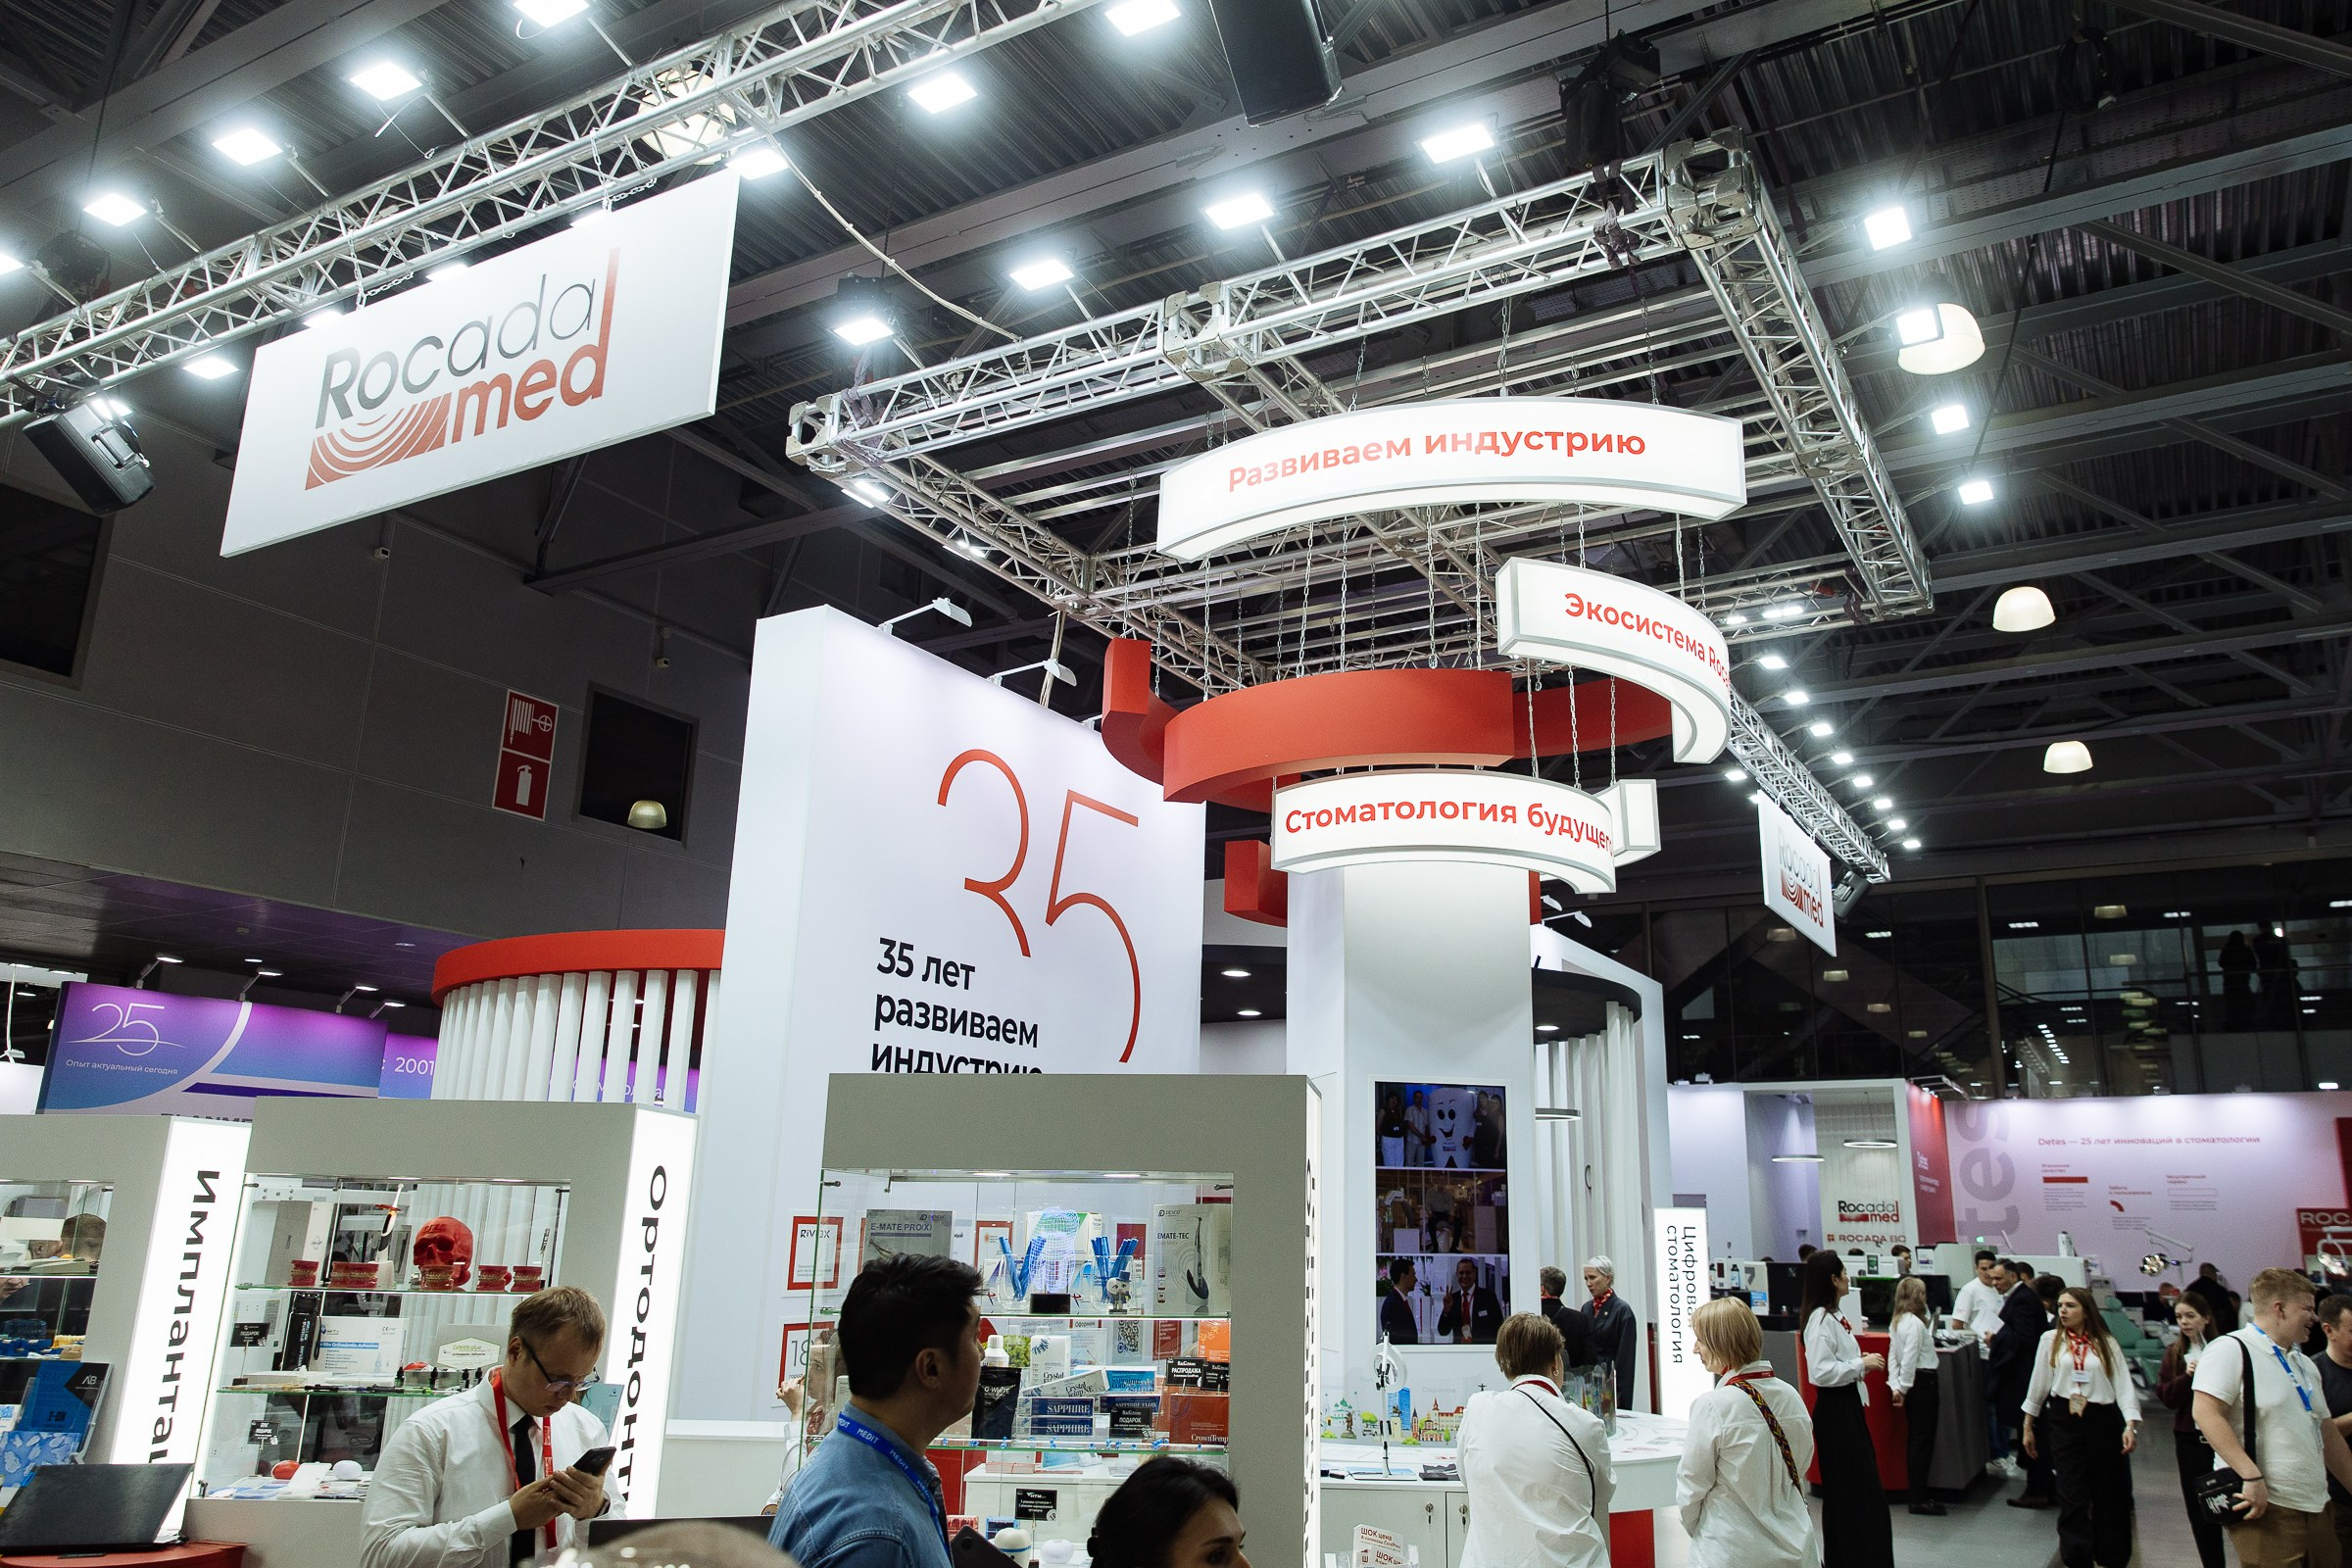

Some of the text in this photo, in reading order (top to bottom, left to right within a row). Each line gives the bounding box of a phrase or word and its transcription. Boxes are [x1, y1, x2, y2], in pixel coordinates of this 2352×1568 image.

[315, 274, 596, 429] Rocada
[451, 246, 621, 443] med
[1228, 425, 1646, 492] Развиваем индустрию
[1565, 593, 1705, 662] Экосистема
[1285, 798, 1517, 834] Стоматология
[876, 937, 976, 991] 35 лет
[91, 1003, 166, 1055] 25
[874, 993, 1039, 1049] развиваем
[66, 1059, 178, 1075] Опыт актуальный сегодня
[2114, 1136, 2173, 1146] инноваций
[1838, 1200, 1895, 1213] Rocada
[1870, 1200, 1899, 1222] med
[2300, 1212, 2352, 1225] ROC
[1682, 1226, 1697, 1318] Цифрова
[1667, 1225, 1683, 1363] стоматология
[617, 1165, 667, 1502] Ортодонт
[1047, 1405, 1090, 1413] SAPPHIRE
[857, 1428, 880, 1445] MEDIT
[1046, 1425, 1090, 1433] SAPPHIRE
[889, 1449, 910, 1470] MEDIT
[1361, 1528, 1377, 1538] ШОК
[1376, 1551, 1393, 1564] ШОК
